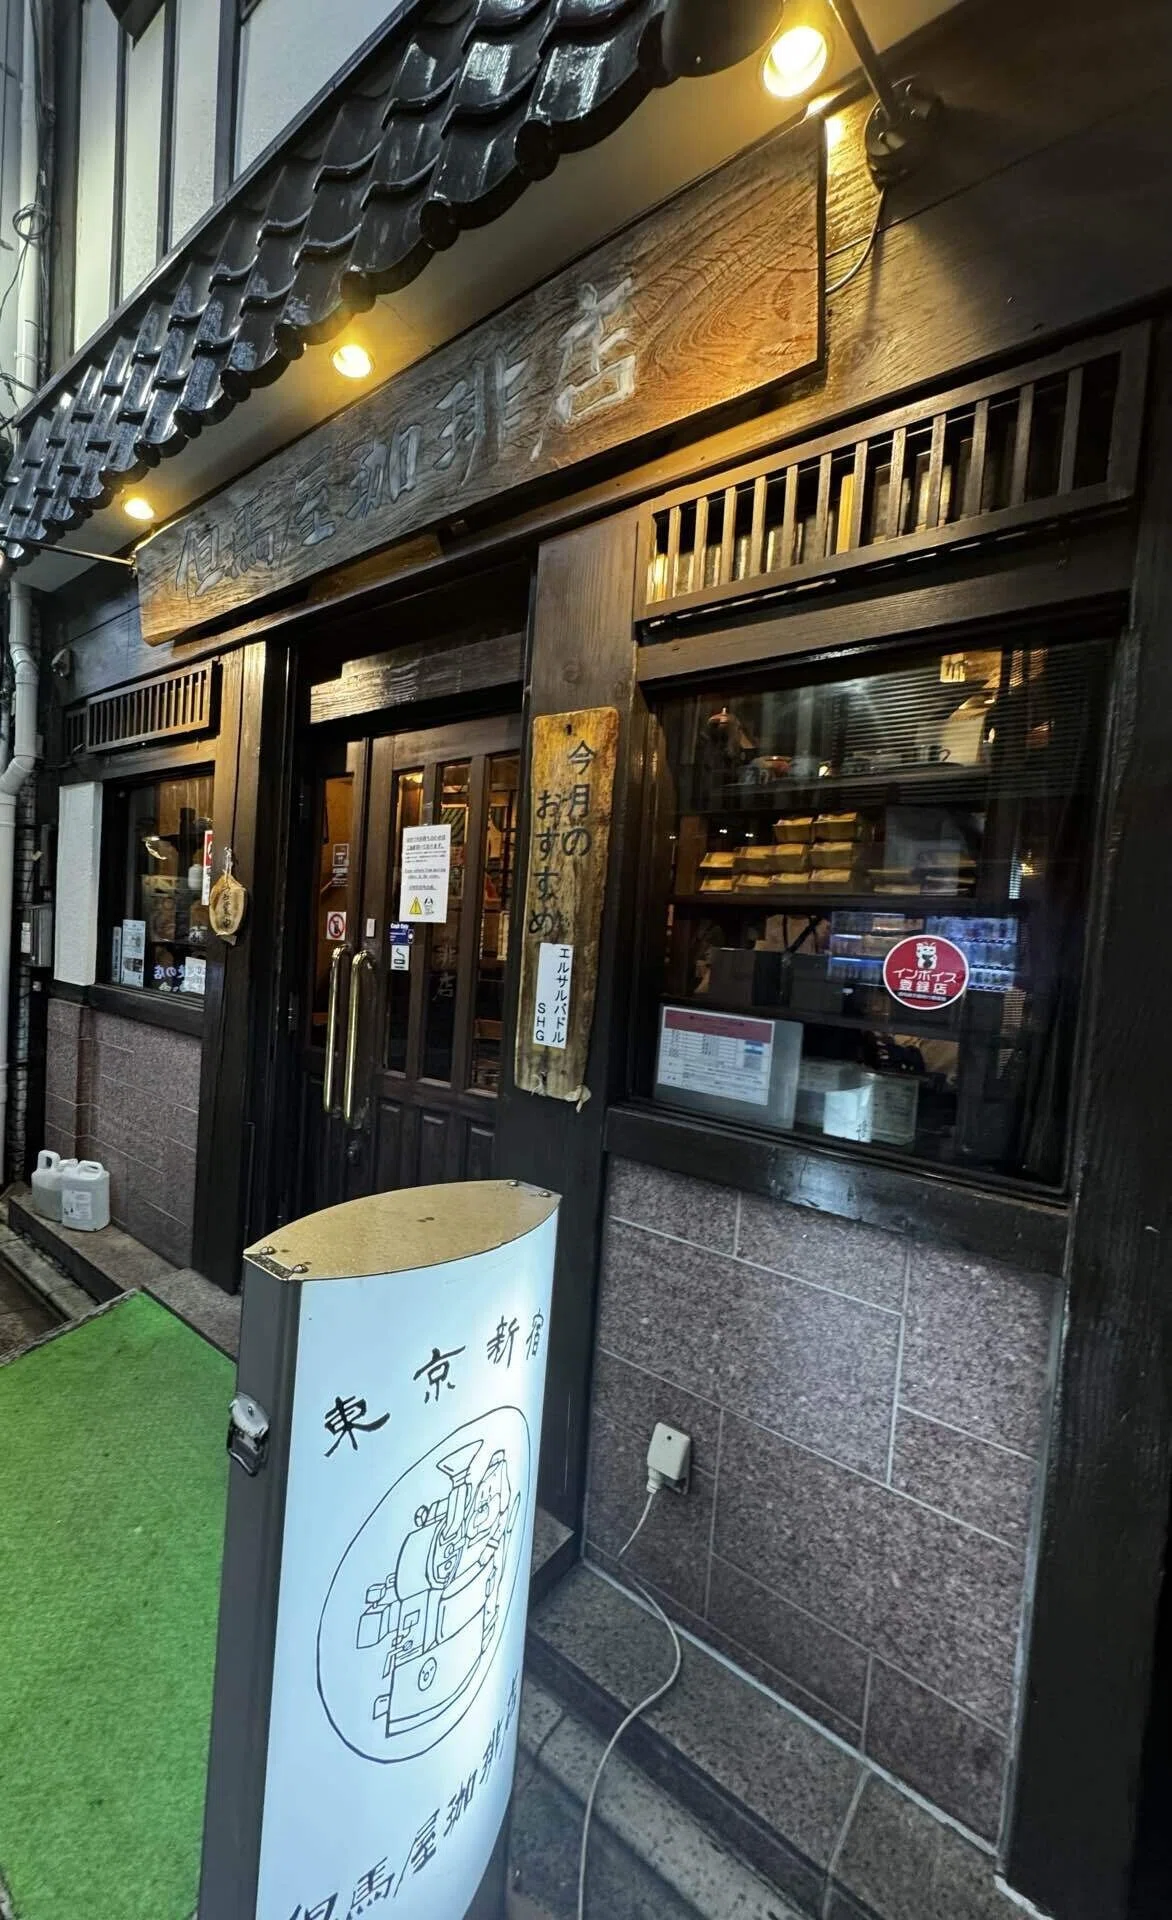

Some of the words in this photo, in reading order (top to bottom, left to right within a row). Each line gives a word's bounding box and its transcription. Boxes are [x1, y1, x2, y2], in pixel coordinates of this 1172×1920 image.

[561, 740, 597, 857] 今月の
[529, 790, 561, 936] おすすめ
[893, 968, 957, 983] インボイス
[535, 1002, 546, 1042] SHG
